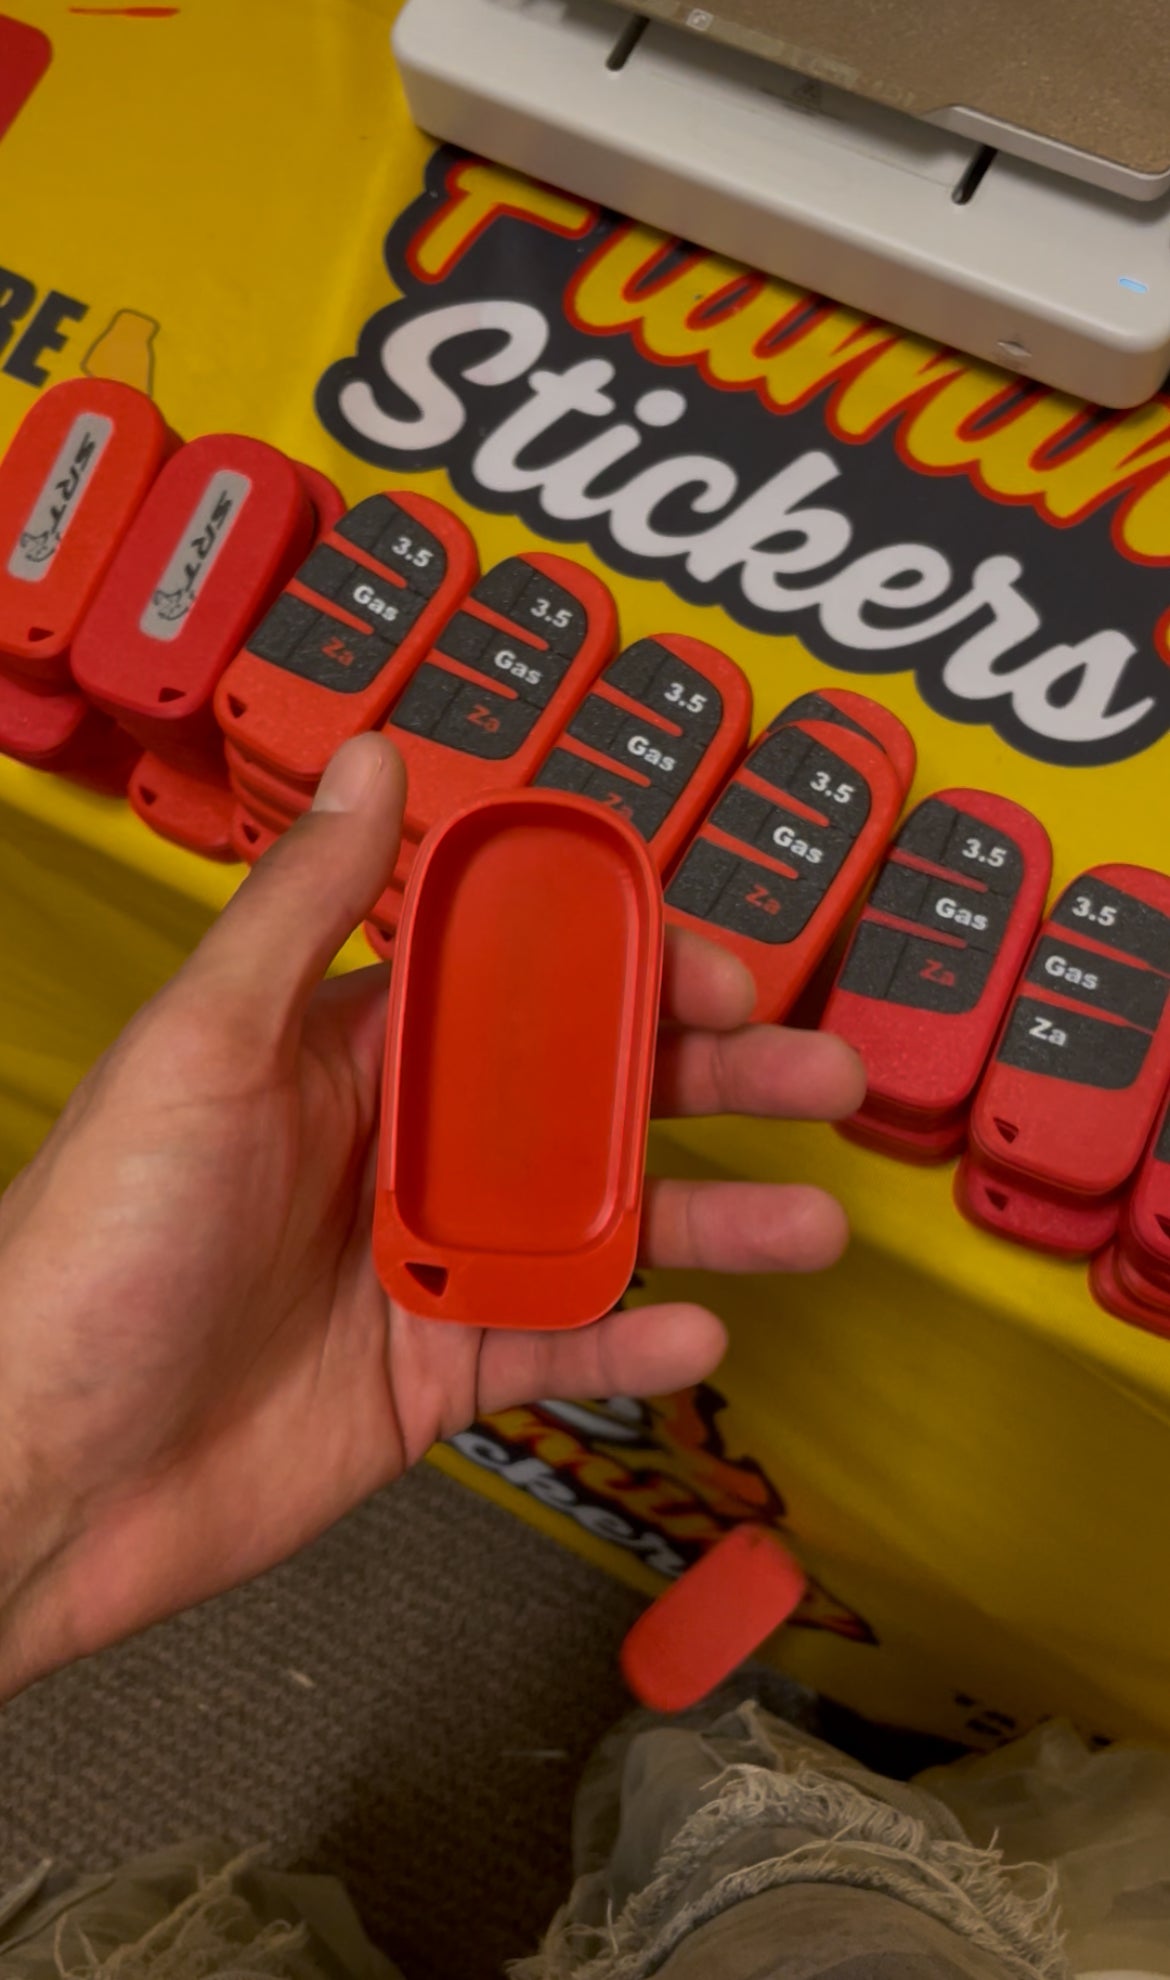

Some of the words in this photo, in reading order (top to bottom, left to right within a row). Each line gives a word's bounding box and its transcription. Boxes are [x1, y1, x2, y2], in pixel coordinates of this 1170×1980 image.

[50, 431, 96, 535] SRT
[339, 299, 1156, 744] Stickers
[185, 489, 232, 592] SRT
[391, 536, 434, 568] 3.5
[352, 584, 399, 621] Gas
[530, 597, 573, 628] 3.5
[321, 637, 353, 666] Za
[493, 650, 542, 685] Gas
[664, 682, 707, 713] 3.5
[466, 704, 499, 733] Za
[627, 735, 676, 771] Gas
[809, 770, 854, 804] 3.5
[772, 826, 823, 864] Gas
[962, 837, 1007, 867] 3.5
[744, 884, 781, 915] Za
[935, 897, 988, 931] Gas
[1072, 896, 1117, 926] 3.5
[919, 959, 955, 987] Za
[1044, 955, 1098, 990] Gas
[1029, 1016, 1067, 1046] Za
